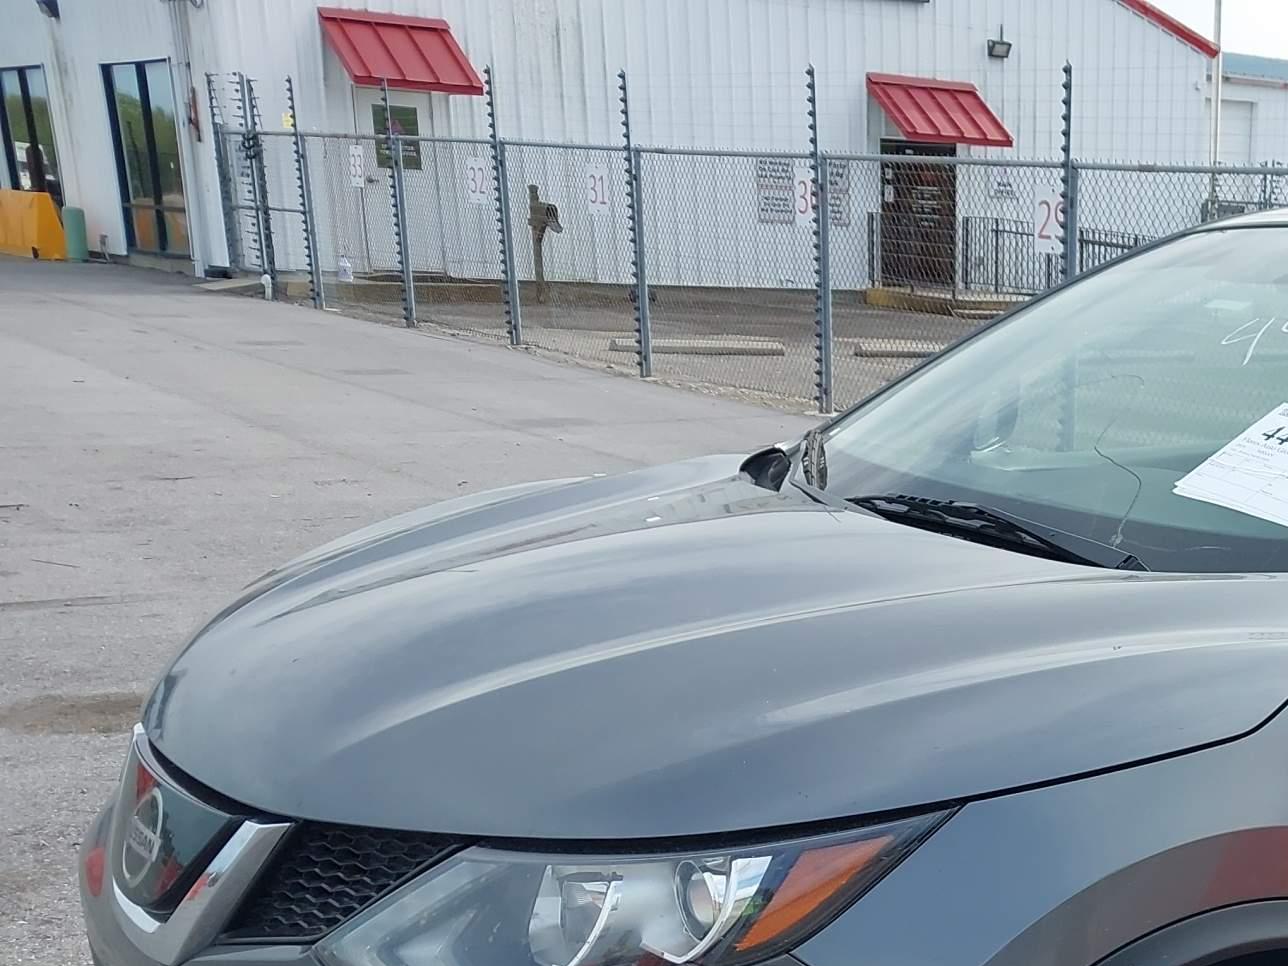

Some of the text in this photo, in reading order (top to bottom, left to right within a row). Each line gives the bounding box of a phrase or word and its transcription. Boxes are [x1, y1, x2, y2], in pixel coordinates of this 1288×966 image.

[350, 153, 363, 179] 33
[468, 166, 487, 194] 32
[589, 174, 608, 205] 31
